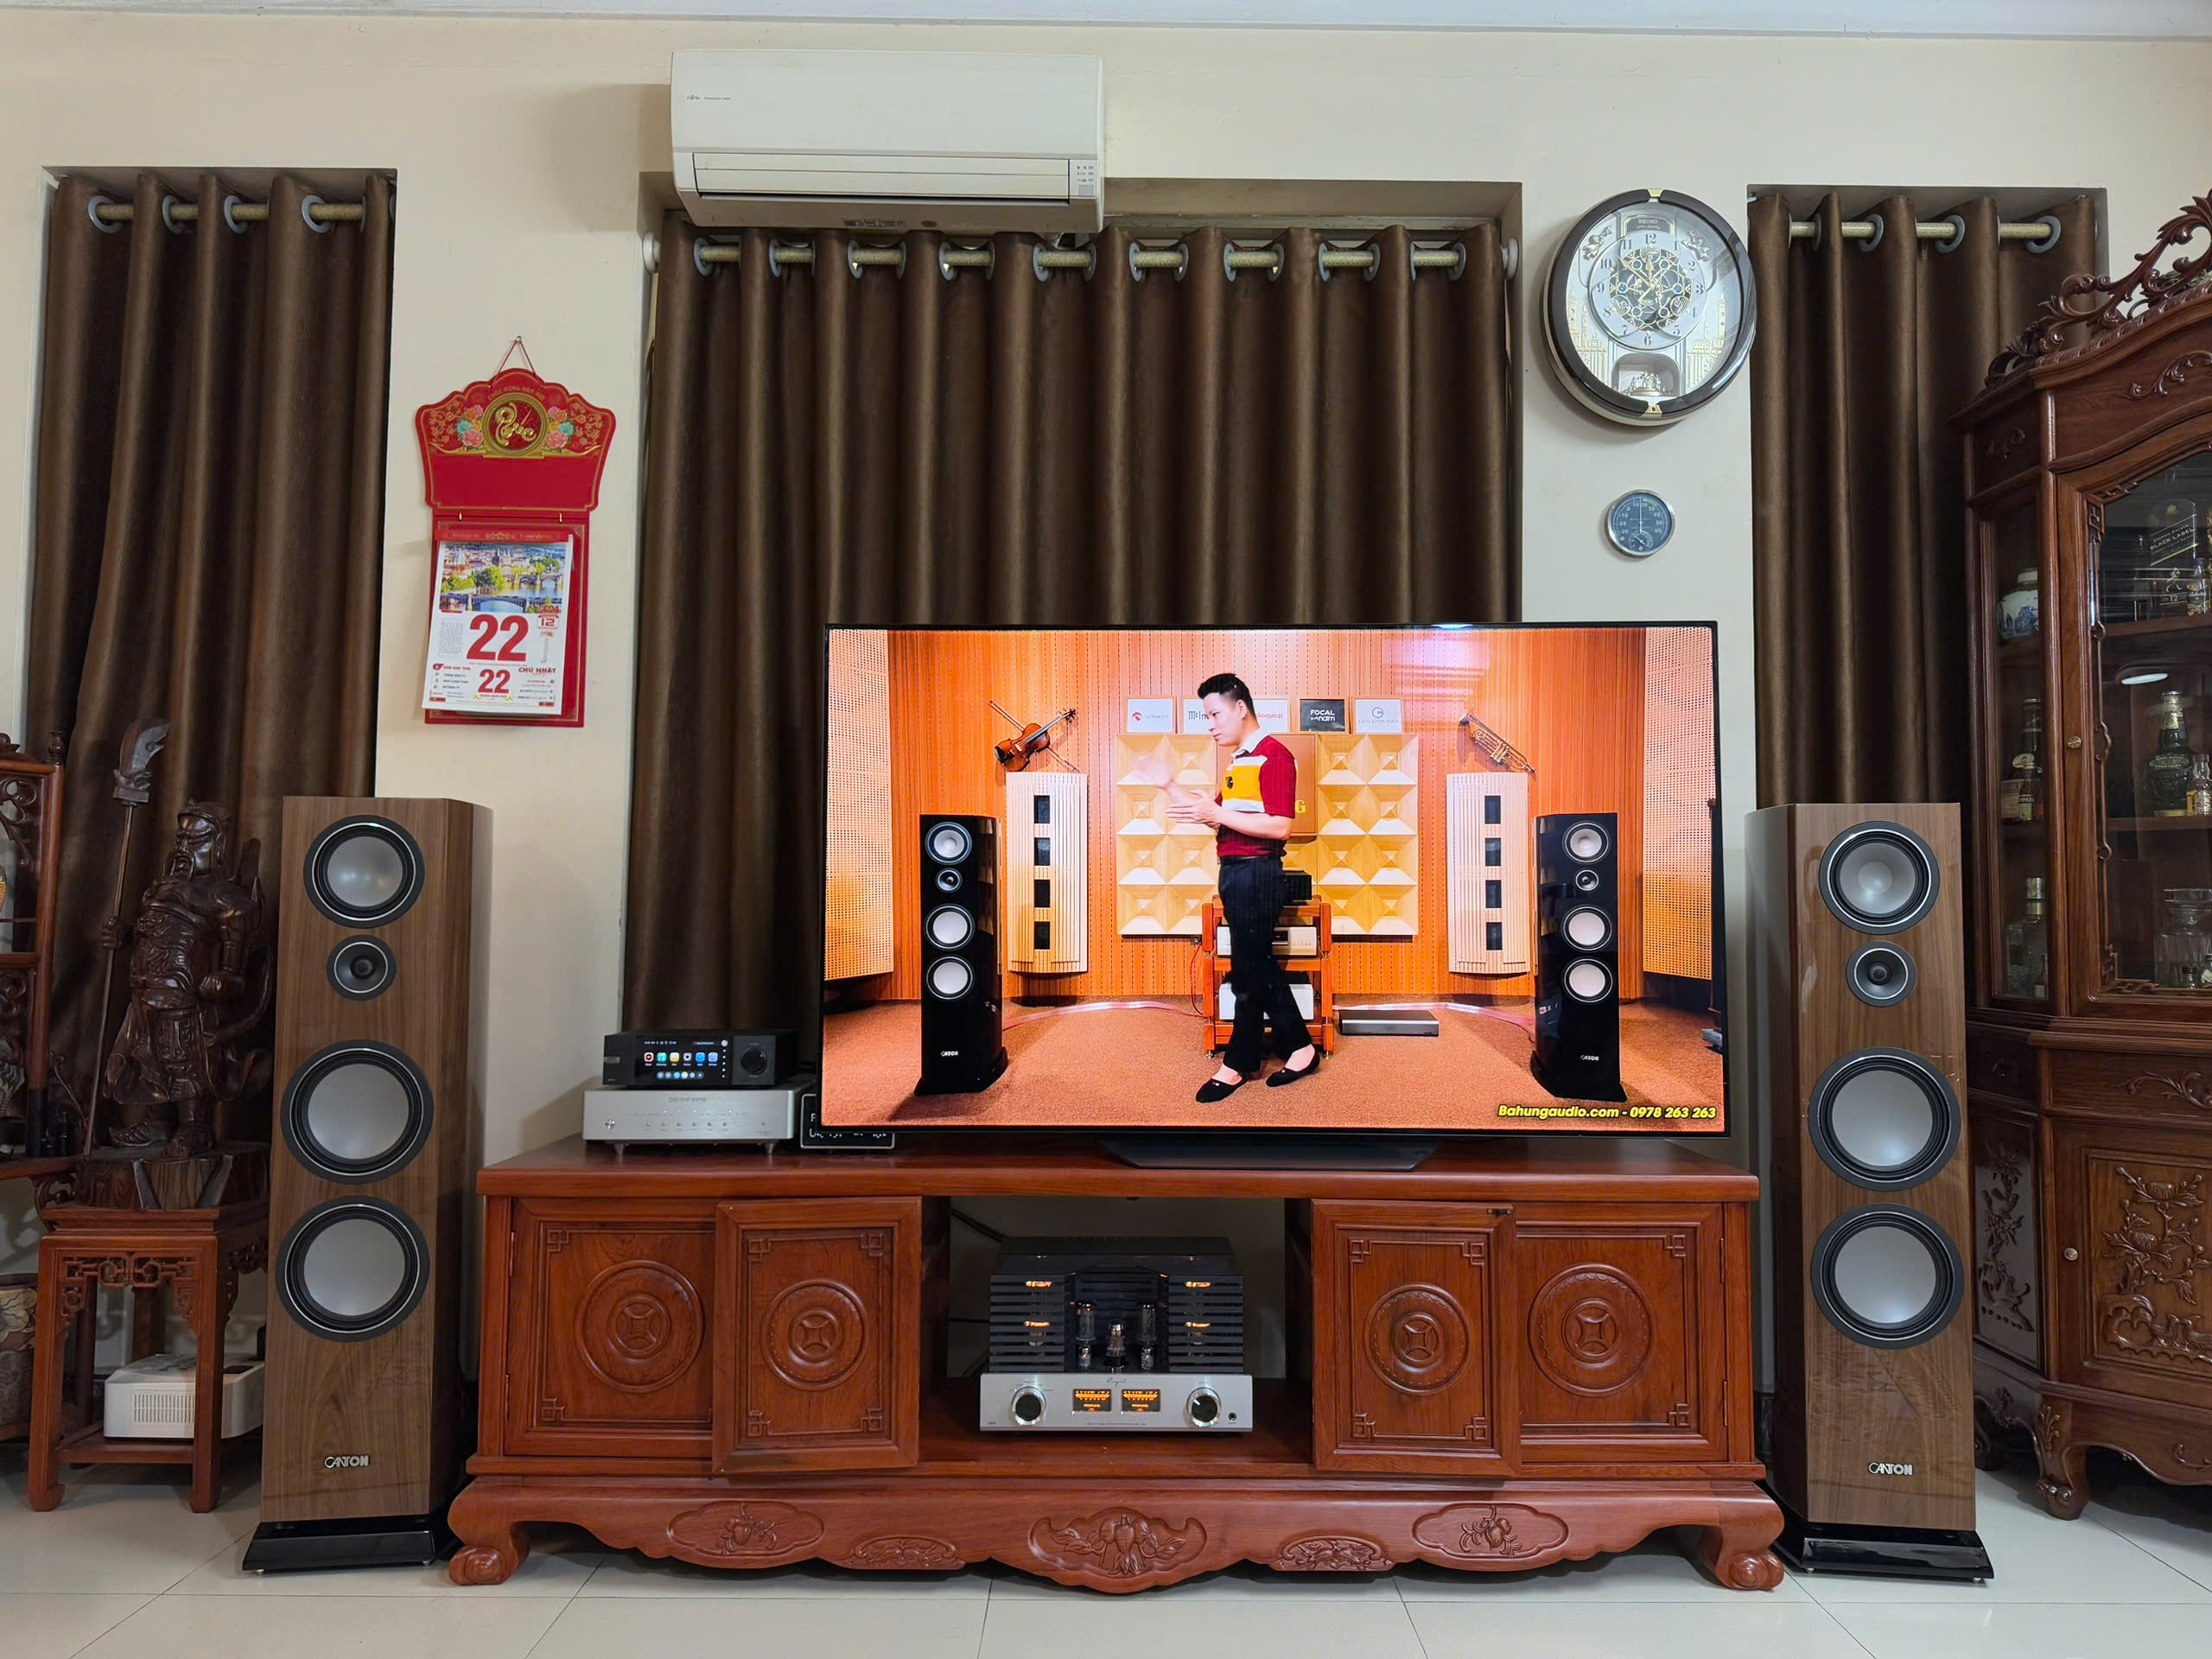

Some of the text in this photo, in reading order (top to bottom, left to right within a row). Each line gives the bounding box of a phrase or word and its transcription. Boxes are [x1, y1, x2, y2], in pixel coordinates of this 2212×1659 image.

[1623, 238, 1632, 250] 11
[1645, 233, 1656, 244] 12
[1674, 240, 1678, 251] 1
[1600, 257, 1612, 270] 10
[1688, 261, 1696, 271] 2
[1597, 283, 1605, 293] 9
[1695, 284, 1704, 295] 3
[1603, 307, 1611, 318] 8
[1689, 307, 1698, 318] 4
[1621, 324, 1629, 335] 7
[1673, 325, 1681, 335] 5
[1643, 335, 1651, 346] 6
[2150, 537, 2171, 550] BLACK
[2172, 528, 2196, 540] LABEL
[467, 613, 529, 662] 22
[478, 669, 511, 694] 22
[1295, 799, 1306, 813] G
[1498, 1105, 1619, 1120] Bahungaudio.com
[1629, 1106, 1662, 1118] 0978
[1664, 1106, 1689, 1119] 263
[1691, 1107, 1717, 1119] 263
